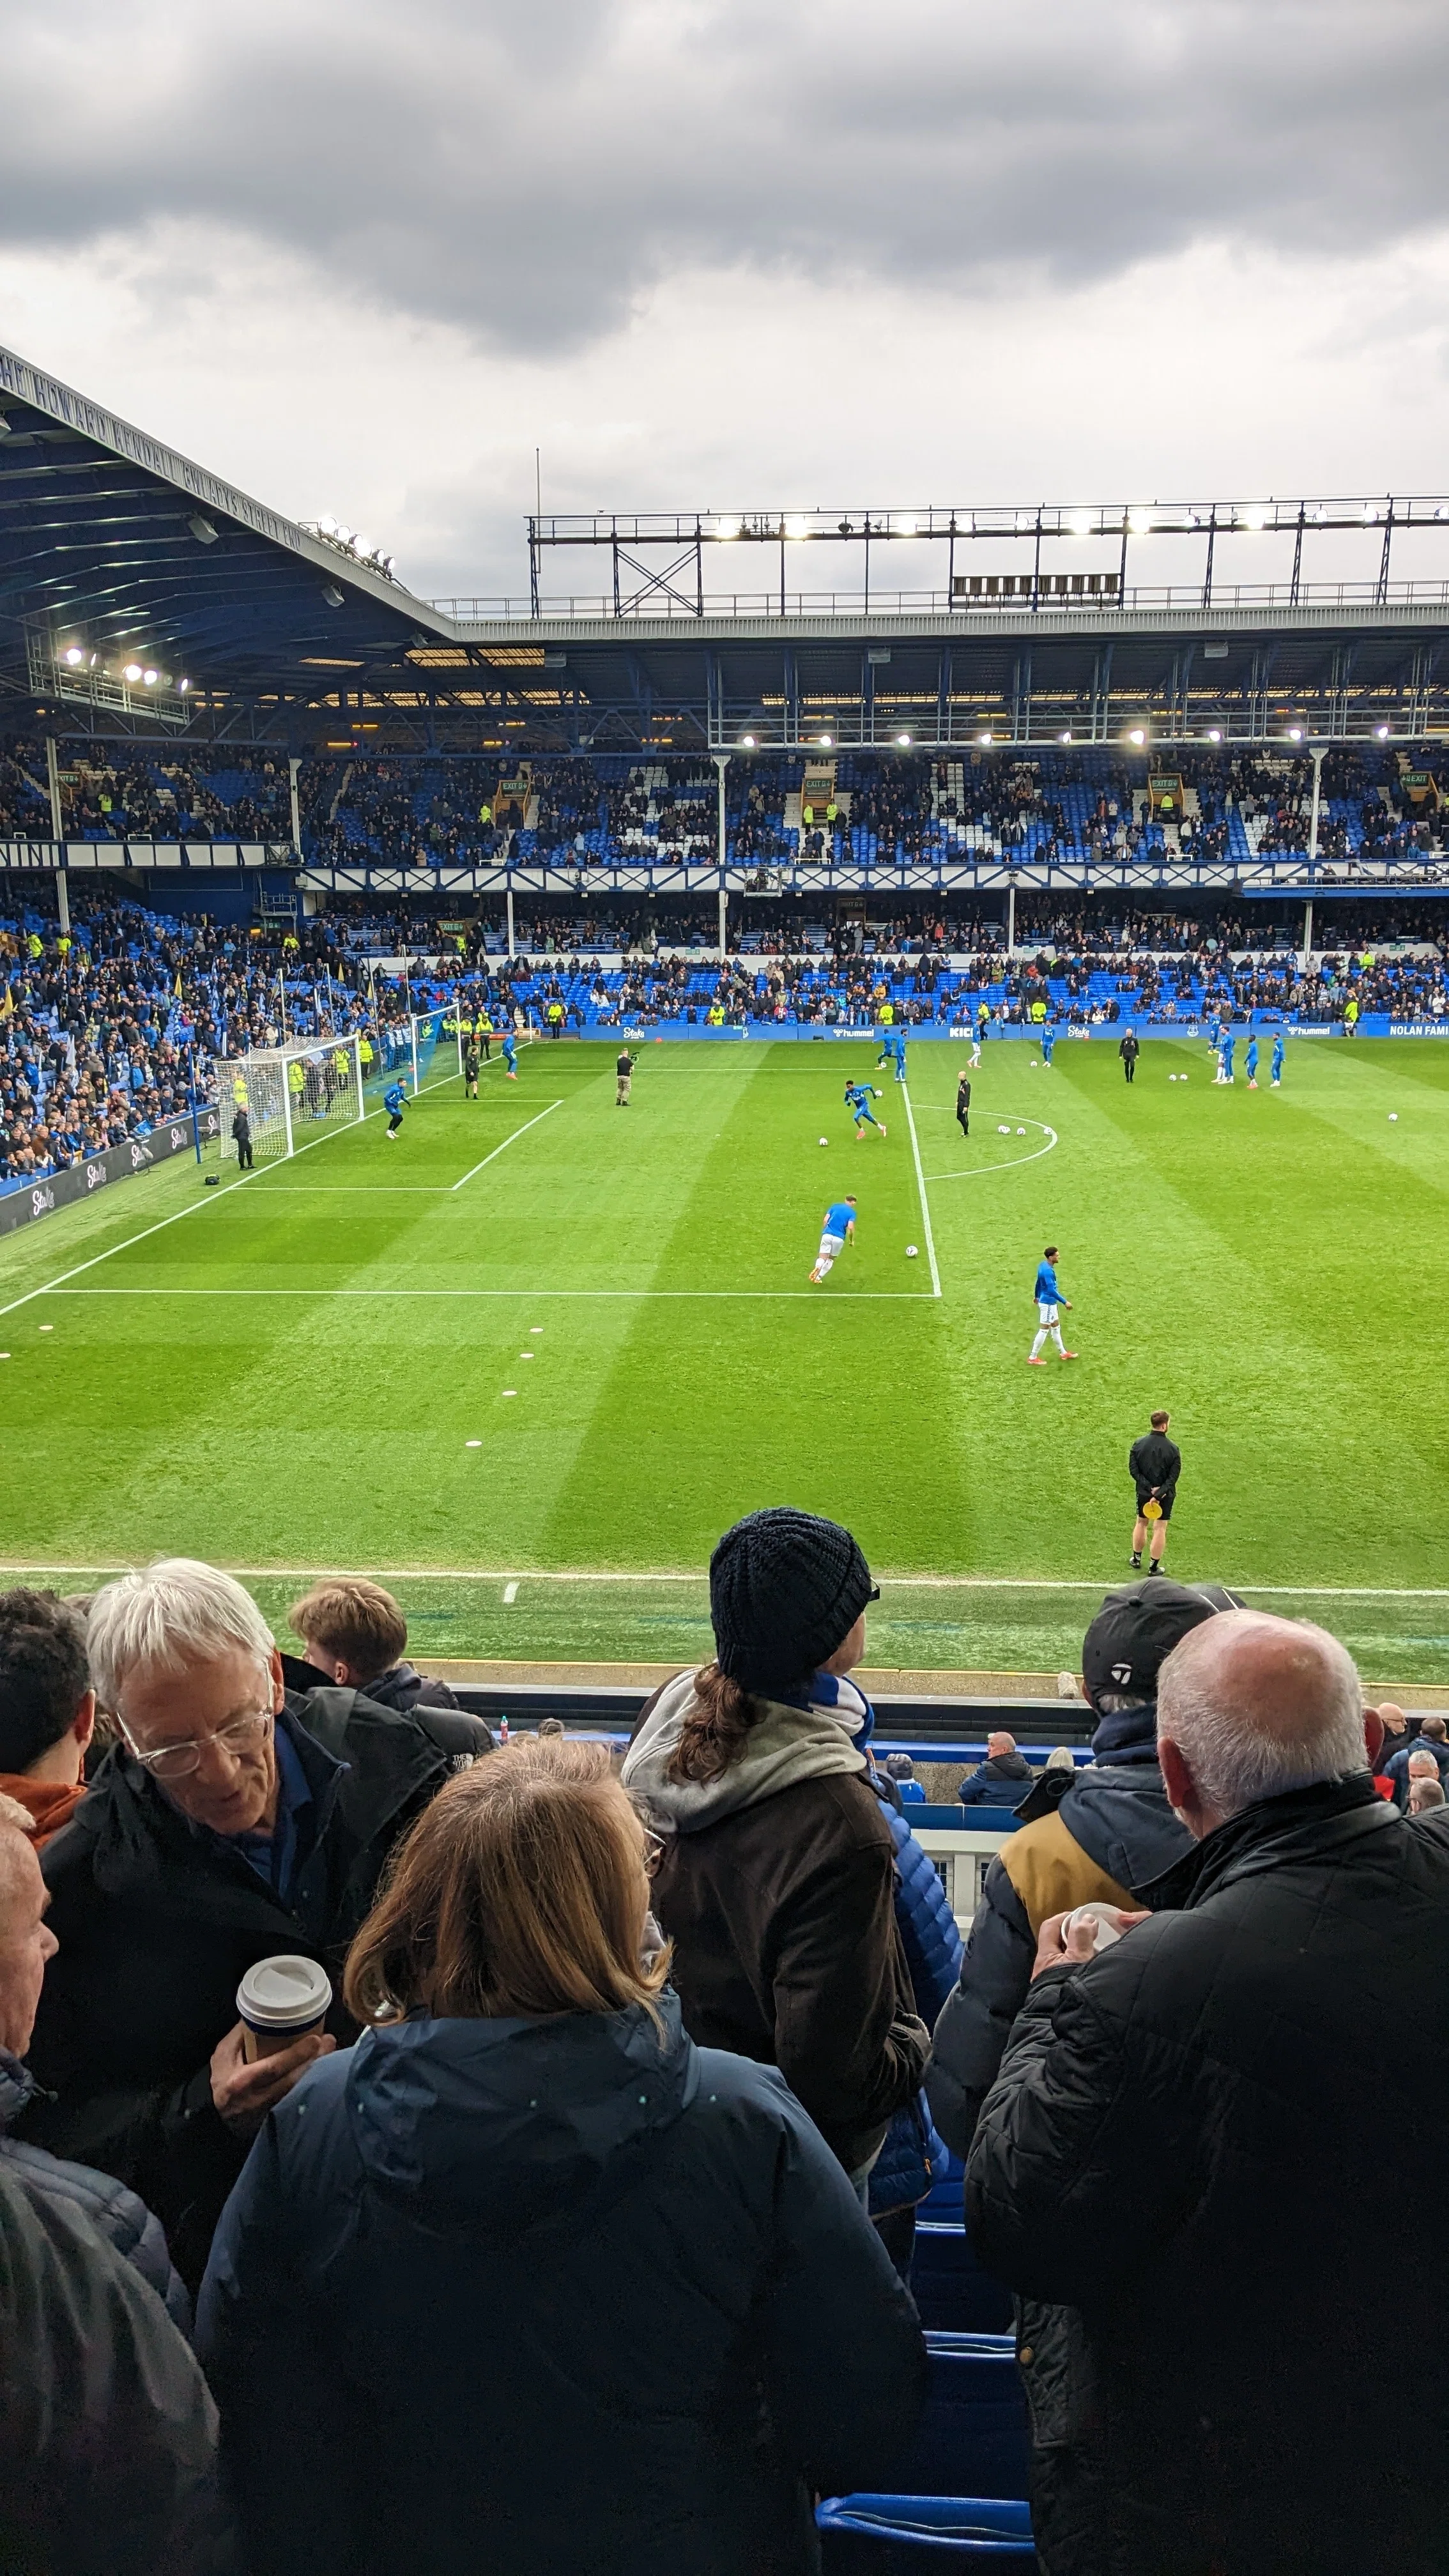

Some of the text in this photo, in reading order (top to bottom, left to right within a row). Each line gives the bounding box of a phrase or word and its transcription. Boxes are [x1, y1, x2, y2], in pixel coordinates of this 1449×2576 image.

[0, 352, 301, 551] HE HOWARD KENDALL GWLADYS STREET END
[623, 1027, 645, 1038] Stake
[843, 1029, 875, 1037] hummel
[1068, 1025, 1090, 1037] Stake
[1298, 1026, 1330, 1035] hummel
[1390, 1025, 1449, 1035] NOLAN FAMI
[131, 1144, 146, 1167] Sta
[87, 1161, 107, 1189] Stake
[32, 1186, 55, 1216] Stake
